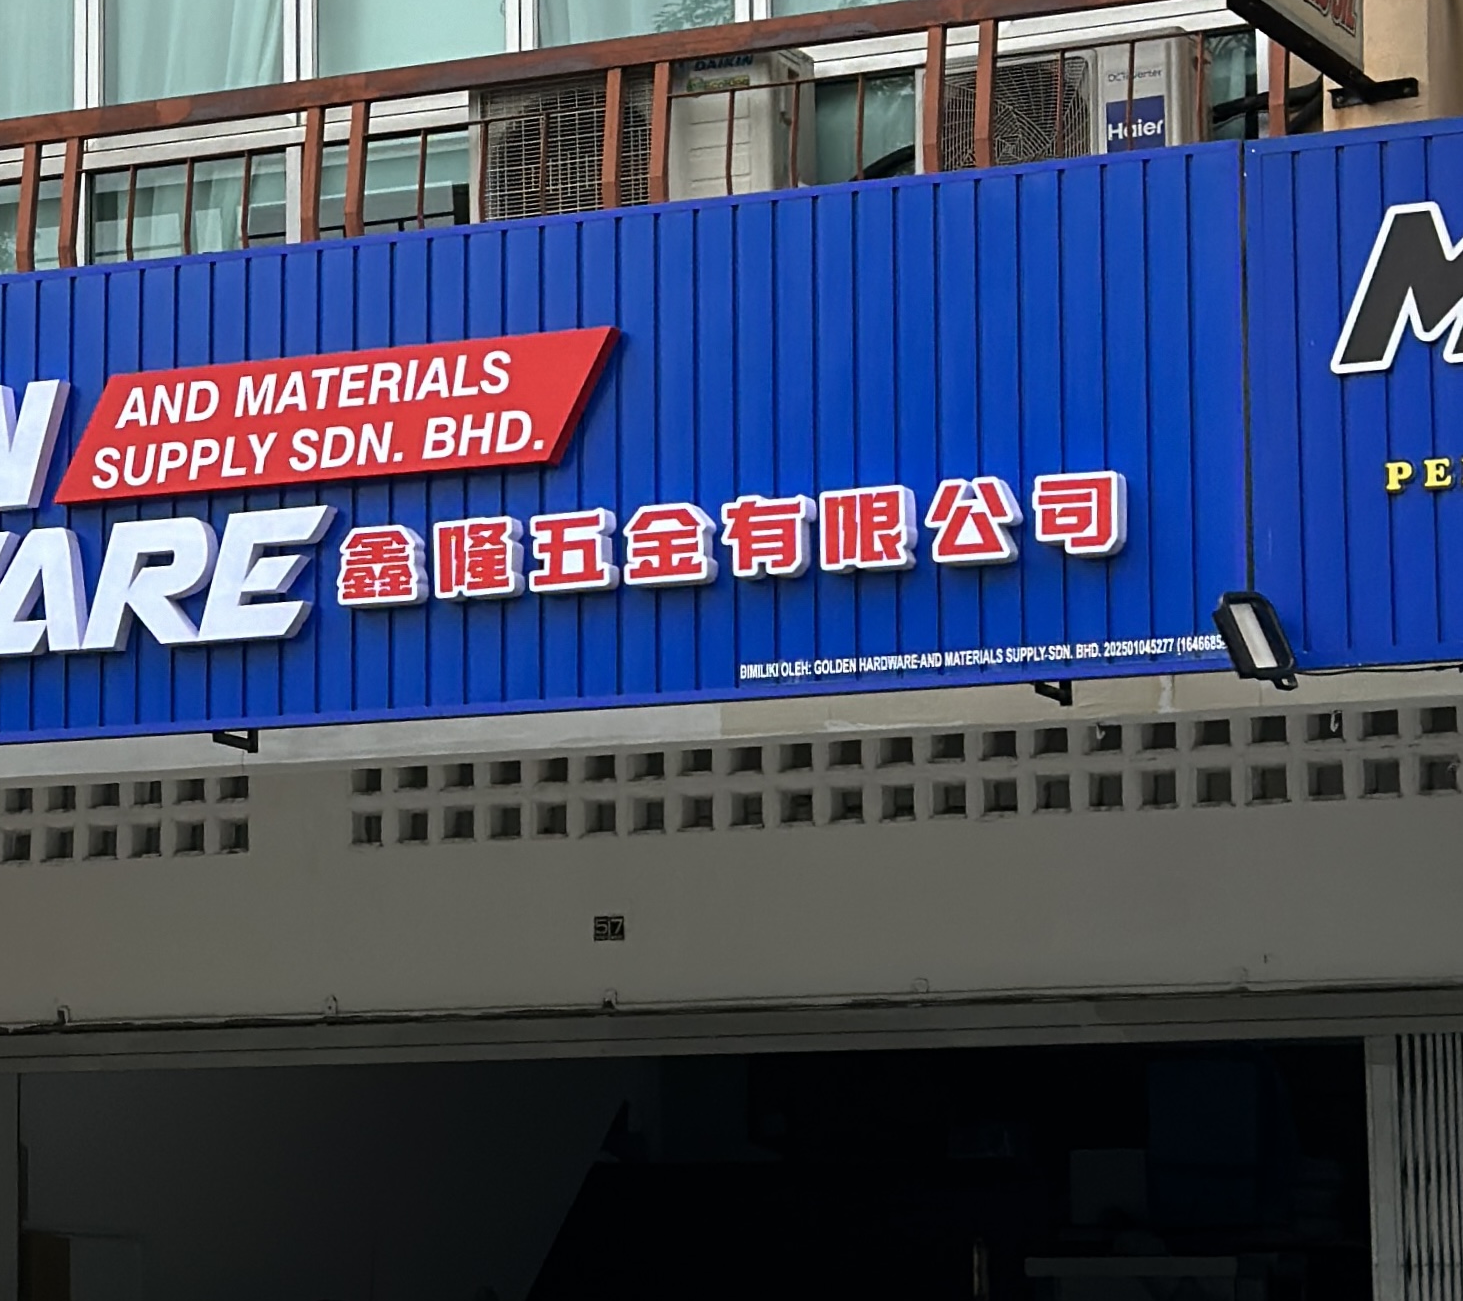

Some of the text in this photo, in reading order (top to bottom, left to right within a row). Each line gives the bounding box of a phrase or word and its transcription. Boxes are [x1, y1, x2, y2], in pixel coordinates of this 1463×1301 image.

[693, 54, 754, 72] DAIKIN
[1108, 119, 1164, 143] Haier
[115, 349, 511, 431] AND MATERIALS
[92, 409, 546, 490] SUPPLY SDN. BHD.
[337, 469, 1129, 609] 鑫隆五金有限公司
[781, 661, 812, 677] OLEH:
[814, 657, 857, 675] GOLDEN
[858, 653, 918, 672] HARDWARE
[919, 652, 942, 669] AND
[944, 647, 1003, 667] MATERIALS
[1005, 645, 1046, 664] SUPPLY
[1048, 643, 1073, 661] SDN.
[1075, 642, 1101, 659] BHD.
[1104, 637, 1175, 658] 202501045277
[595, 918, 624, 935] 57
